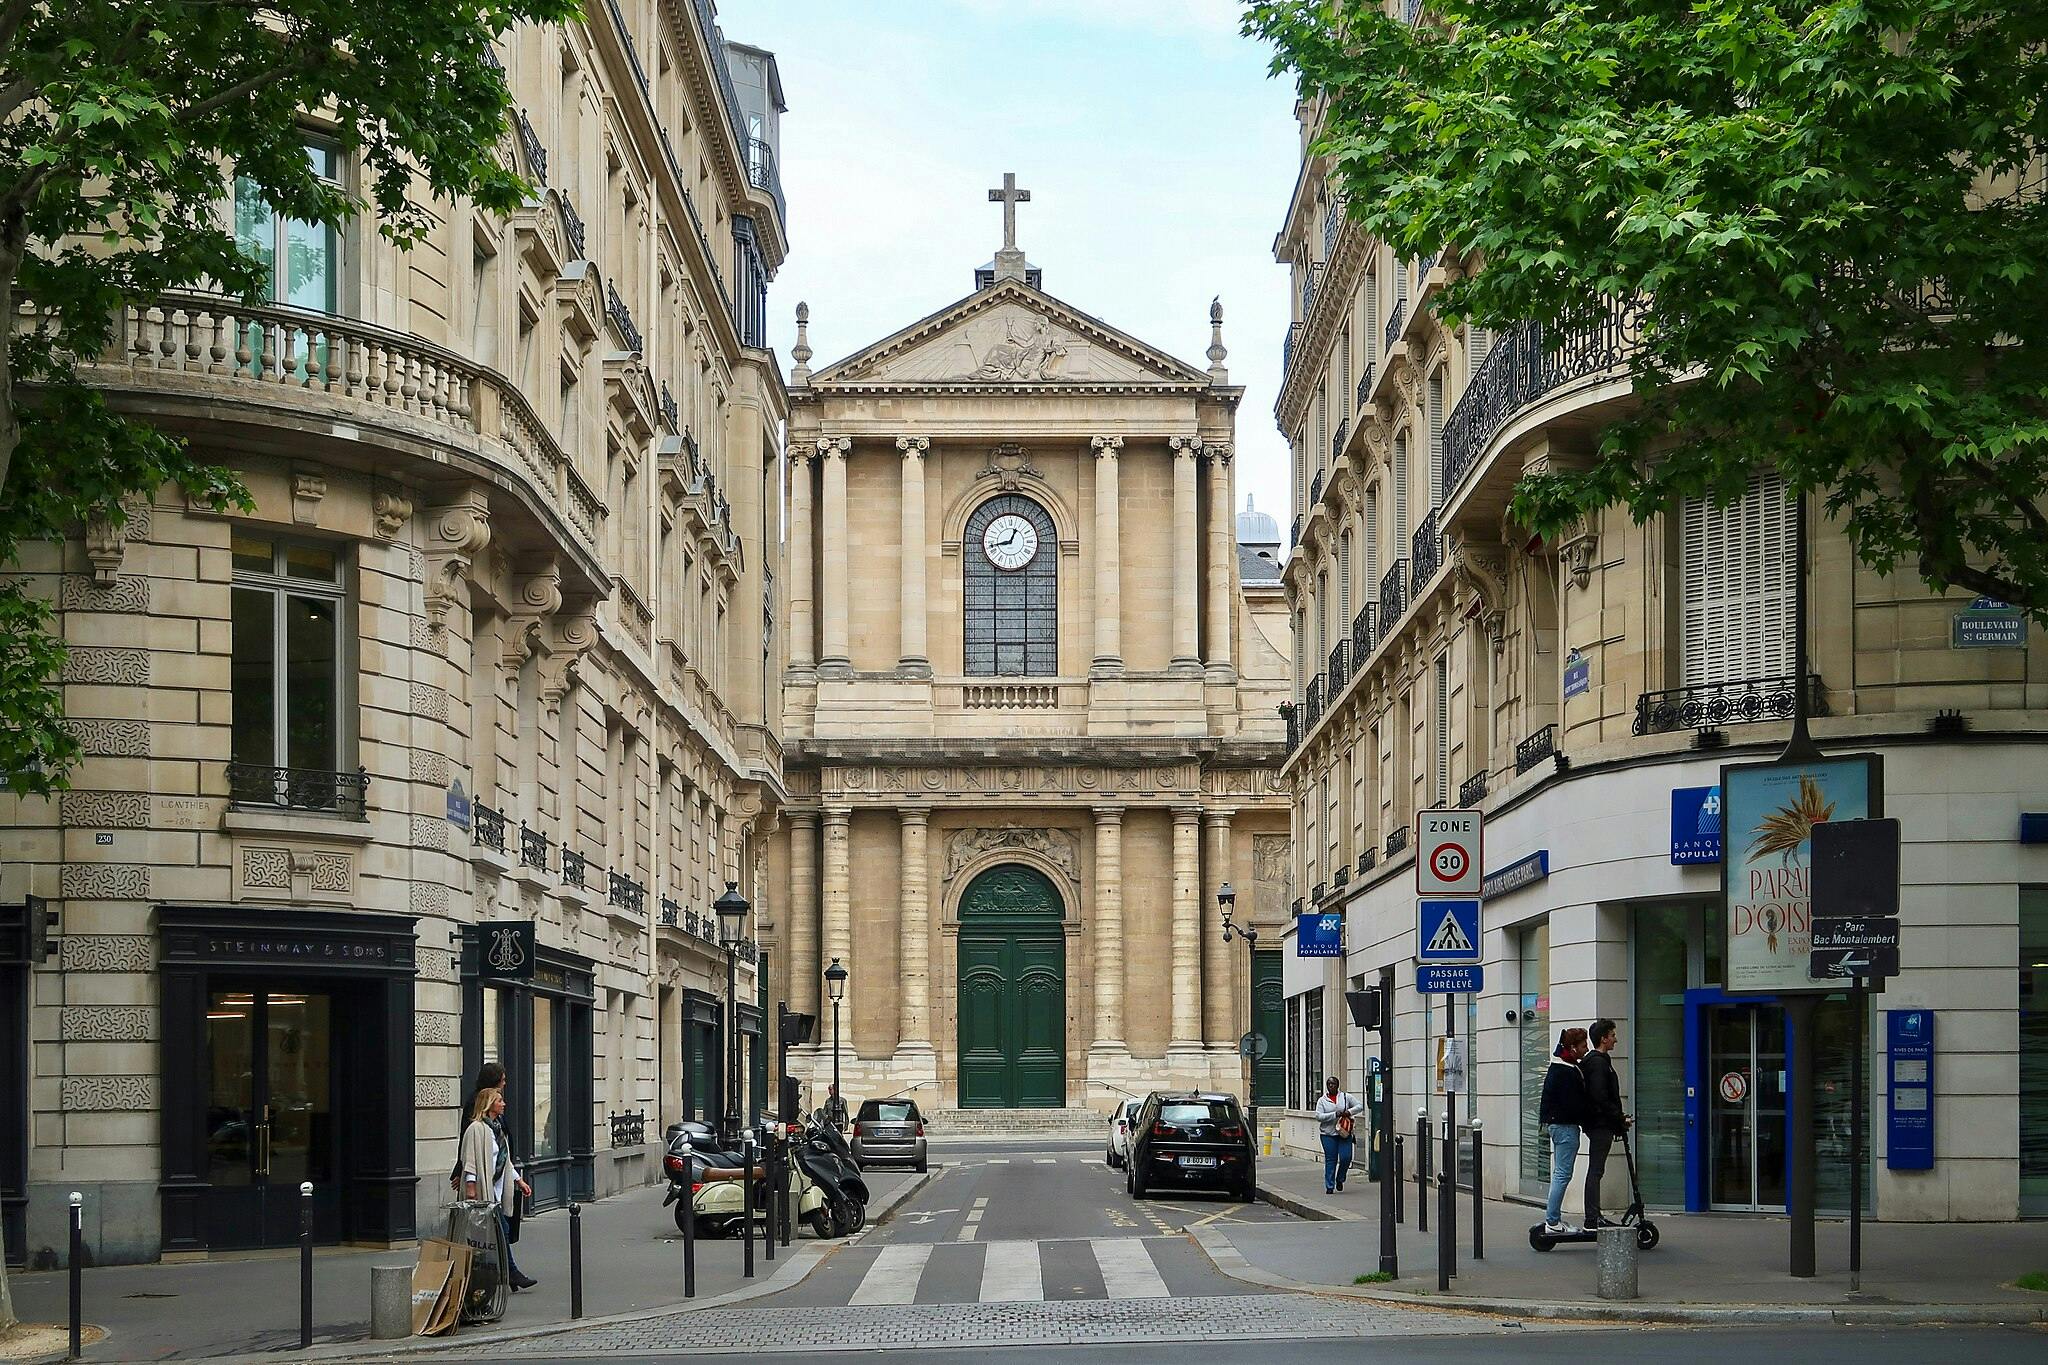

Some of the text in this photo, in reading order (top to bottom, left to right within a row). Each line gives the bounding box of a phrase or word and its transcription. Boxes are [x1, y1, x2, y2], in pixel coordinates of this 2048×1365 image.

[1962, 621, 2018, 630] BOULEVARD
[1976, 632, 2017, 641] GERMAIN
[1430, 821, 1471, 832] ZONE
[98, 834, 112, 843] 230
[1674, 850, 1719, 859] POPULAI
[1439, 856, 1461, 870] 30
[1844, 921, 1865, 932] Parc
[1813, 933, 1896, 945] Bac Montalembert
[209, 941, 385, 958] STEINWAY & SONS
[1430, 969, 1469, 978] PASSAGE
[1427, 980, 1472, 989] SURÉLEVÉ
